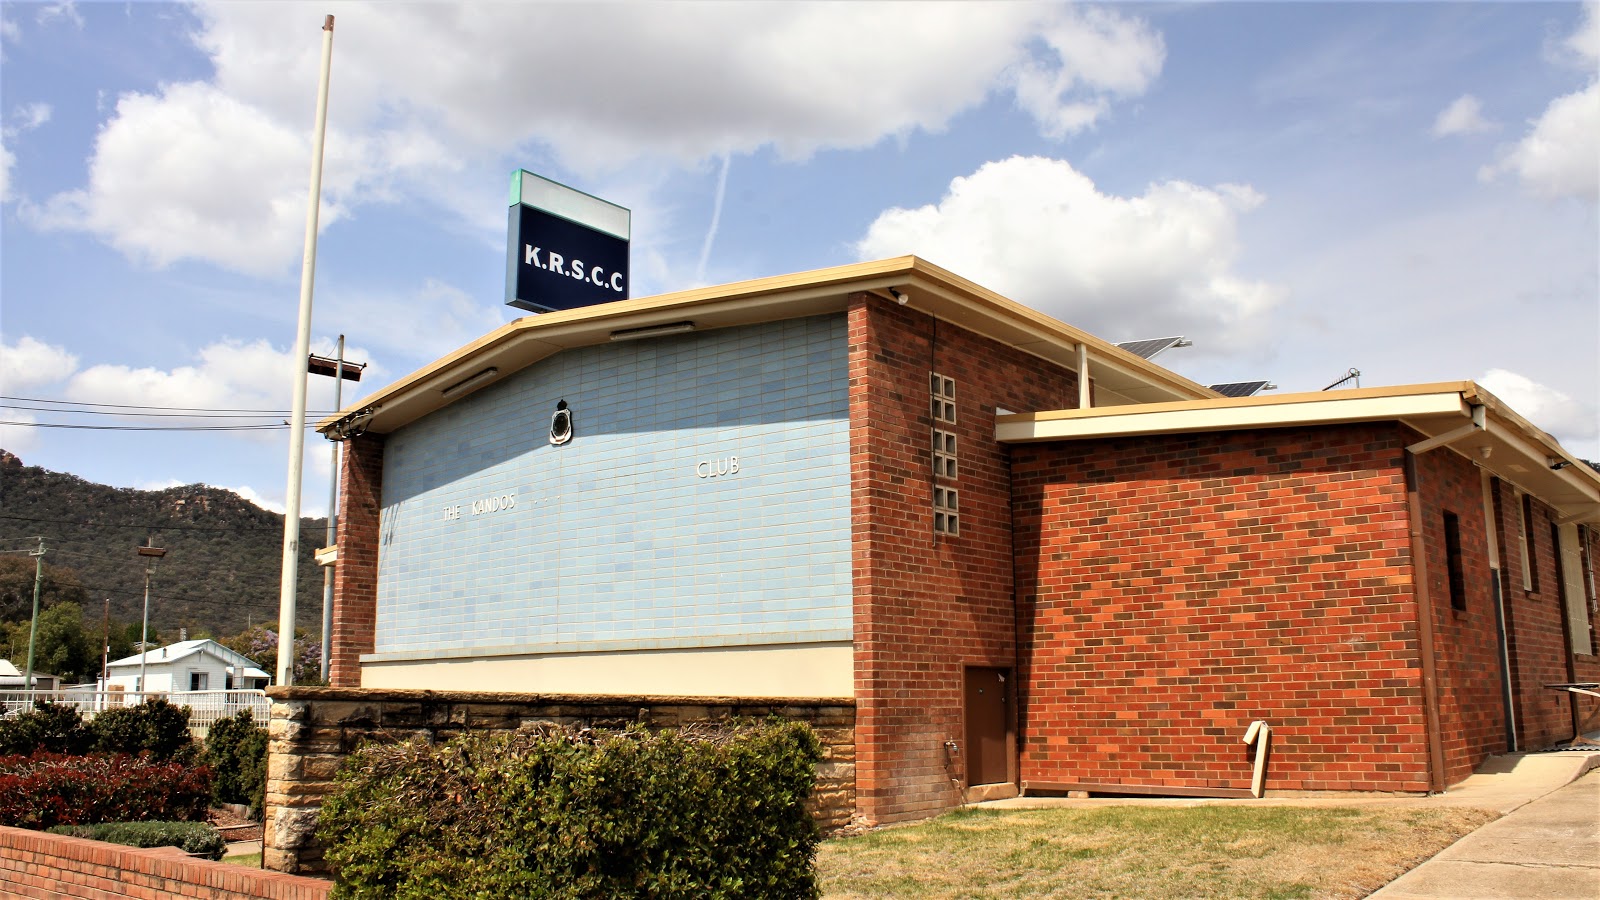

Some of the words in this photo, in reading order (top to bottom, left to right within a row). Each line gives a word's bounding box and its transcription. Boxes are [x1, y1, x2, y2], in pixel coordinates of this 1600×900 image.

[525, 243, 623, 292] K.R.S.C.C
[443, 504, 460, 521] THE
[472, 493, 515, 516] KANDOS
[697, 456, 739, 478] CLUB
